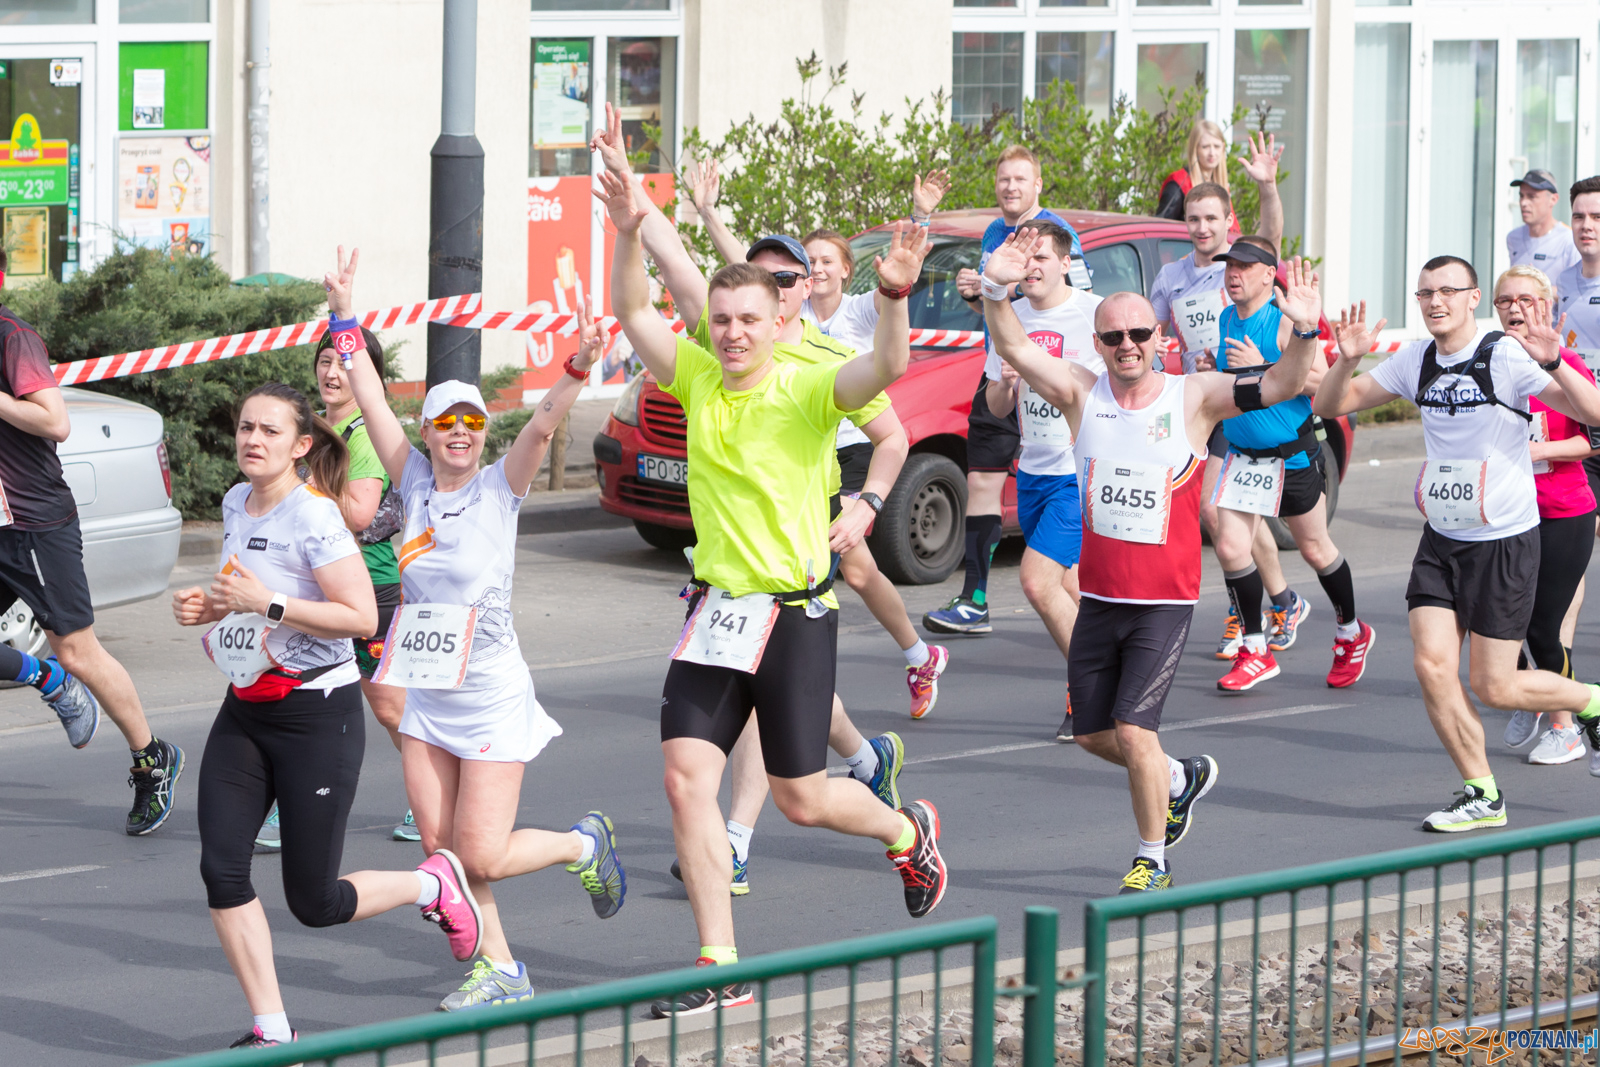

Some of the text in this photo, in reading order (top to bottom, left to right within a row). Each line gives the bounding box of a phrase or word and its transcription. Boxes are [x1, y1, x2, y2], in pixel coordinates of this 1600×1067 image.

[1186, 309, 1217, 328] 394
[1023, 400, 1062, 419] 1460
[1435, 406, 1476, 414] PARNERS
[646, 458, 668, 480] PO
[1233, 470, 1274, 490] 4298
[1100, 485, 1157, 510] 8455
[1428, 482, 1474, 501] 4608
[1109, 509, 1144, 519] GRZEGORZ
[708, 609, 748, 635] 941
[218, 626, 255, 650] 1602
[401, 630, 457, 654] 4805
[710, 633, 731, 642] Marcin
[408, 656, 440, 665] Agnieszka
